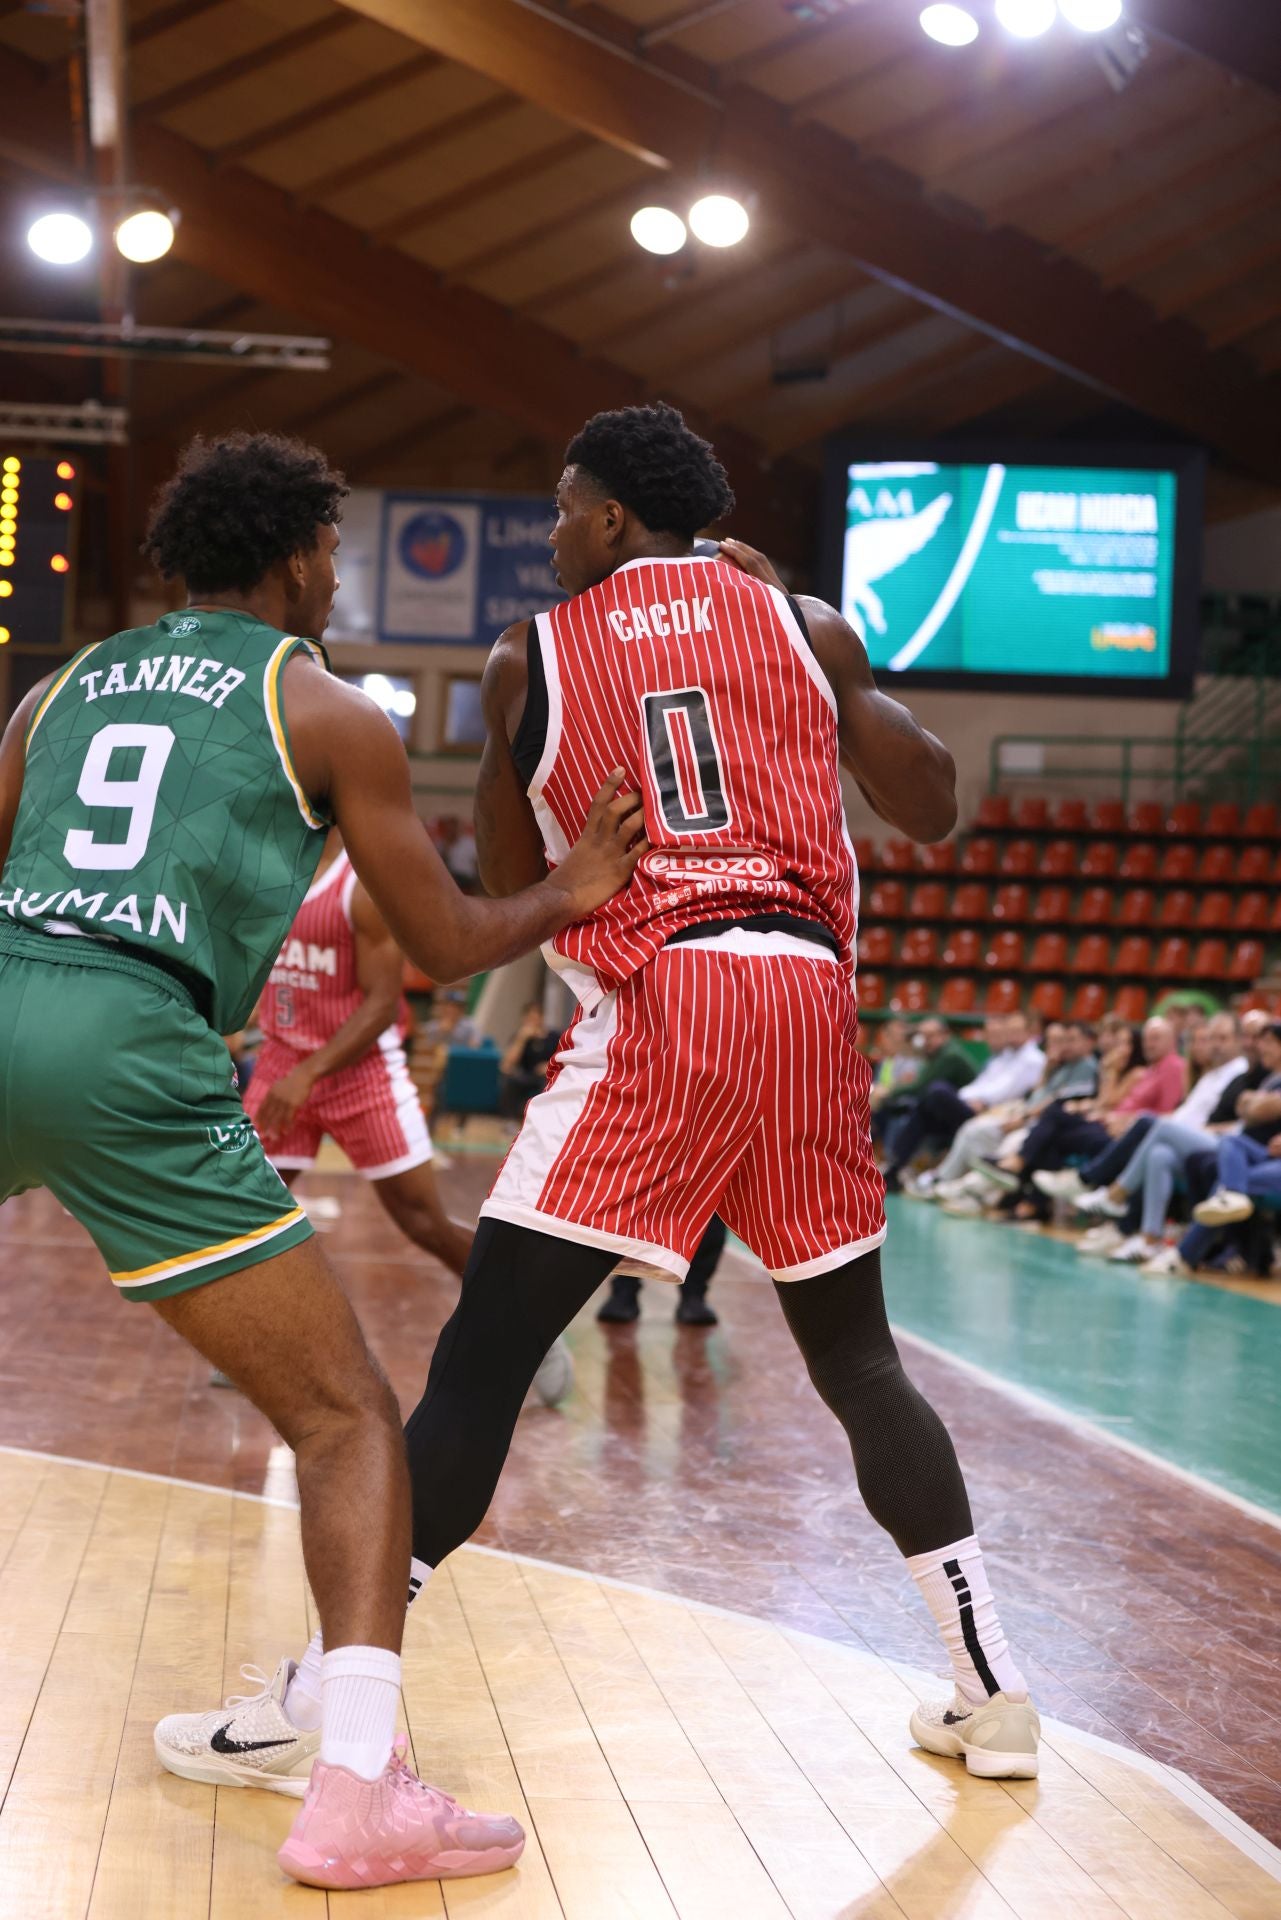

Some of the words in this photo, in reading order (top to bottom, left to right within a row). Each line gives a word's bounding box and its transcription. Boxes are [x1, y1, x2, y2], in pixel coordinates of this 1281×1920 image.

[608, 596, 713, 642] CACOK
[79, 655, 246, 709] TANNER
[640, 685, 733, 836] 0
[63, 723, 176, 870] 9
[0, 888, 187, 944] HUMAN
